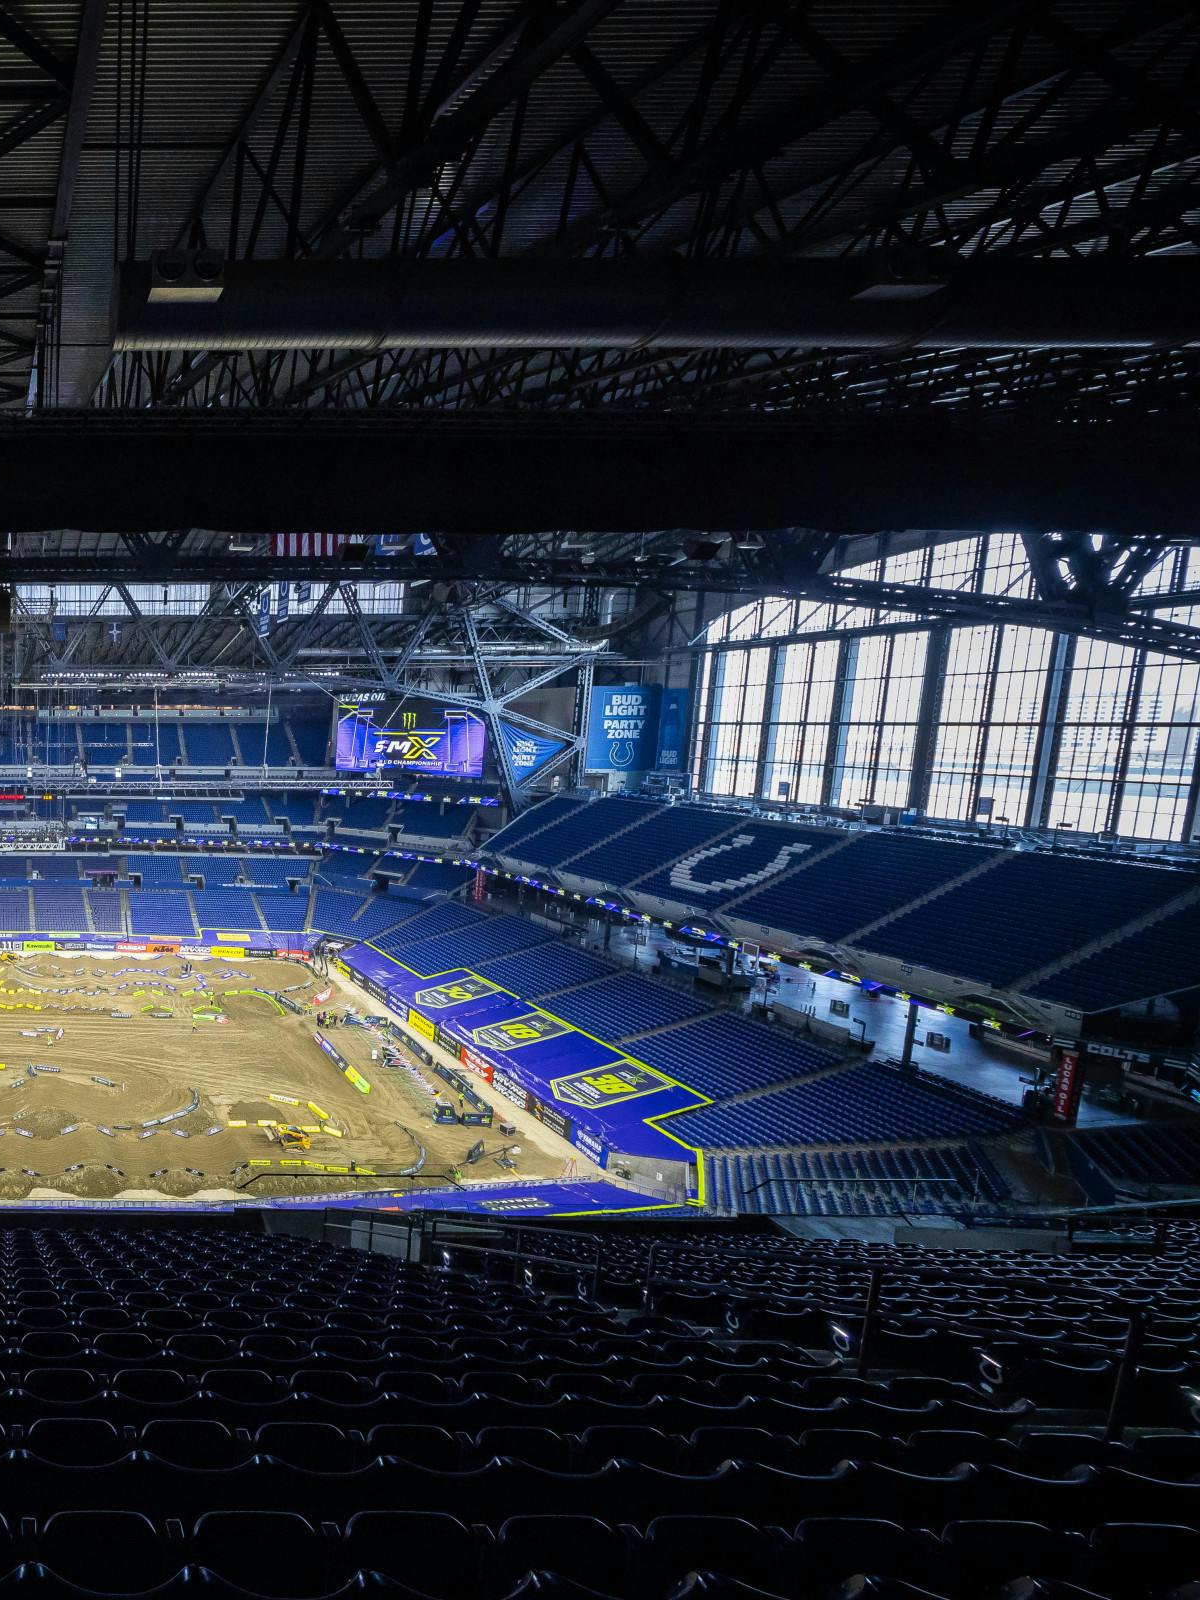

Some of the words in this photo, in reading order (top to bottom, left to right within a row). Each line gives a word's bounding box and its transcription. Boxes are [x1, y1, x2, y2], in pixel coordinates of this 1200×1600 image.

[340, 693, 369, 701] LUCAS
[371, 692, 386, 701] OIL
[612, 695, 642, 705] BUD
[605, 705, 647, 716] LIGHT
[603, 719, 645, 730] PARTY
[607, 729, 641, 739] ZONE
[374, 736, 441, 759] SMX
[661, 750, 677, 758] BUD
[659, 757, 678, 765] LIGHT
[1087, 1043, 1150, 1063] COLTS
[1061, 1057, 1073, 1091] LUCAS
[581, 1073, 638, 1095] 38
[1057, 1092, 1066, 1113] OIL
